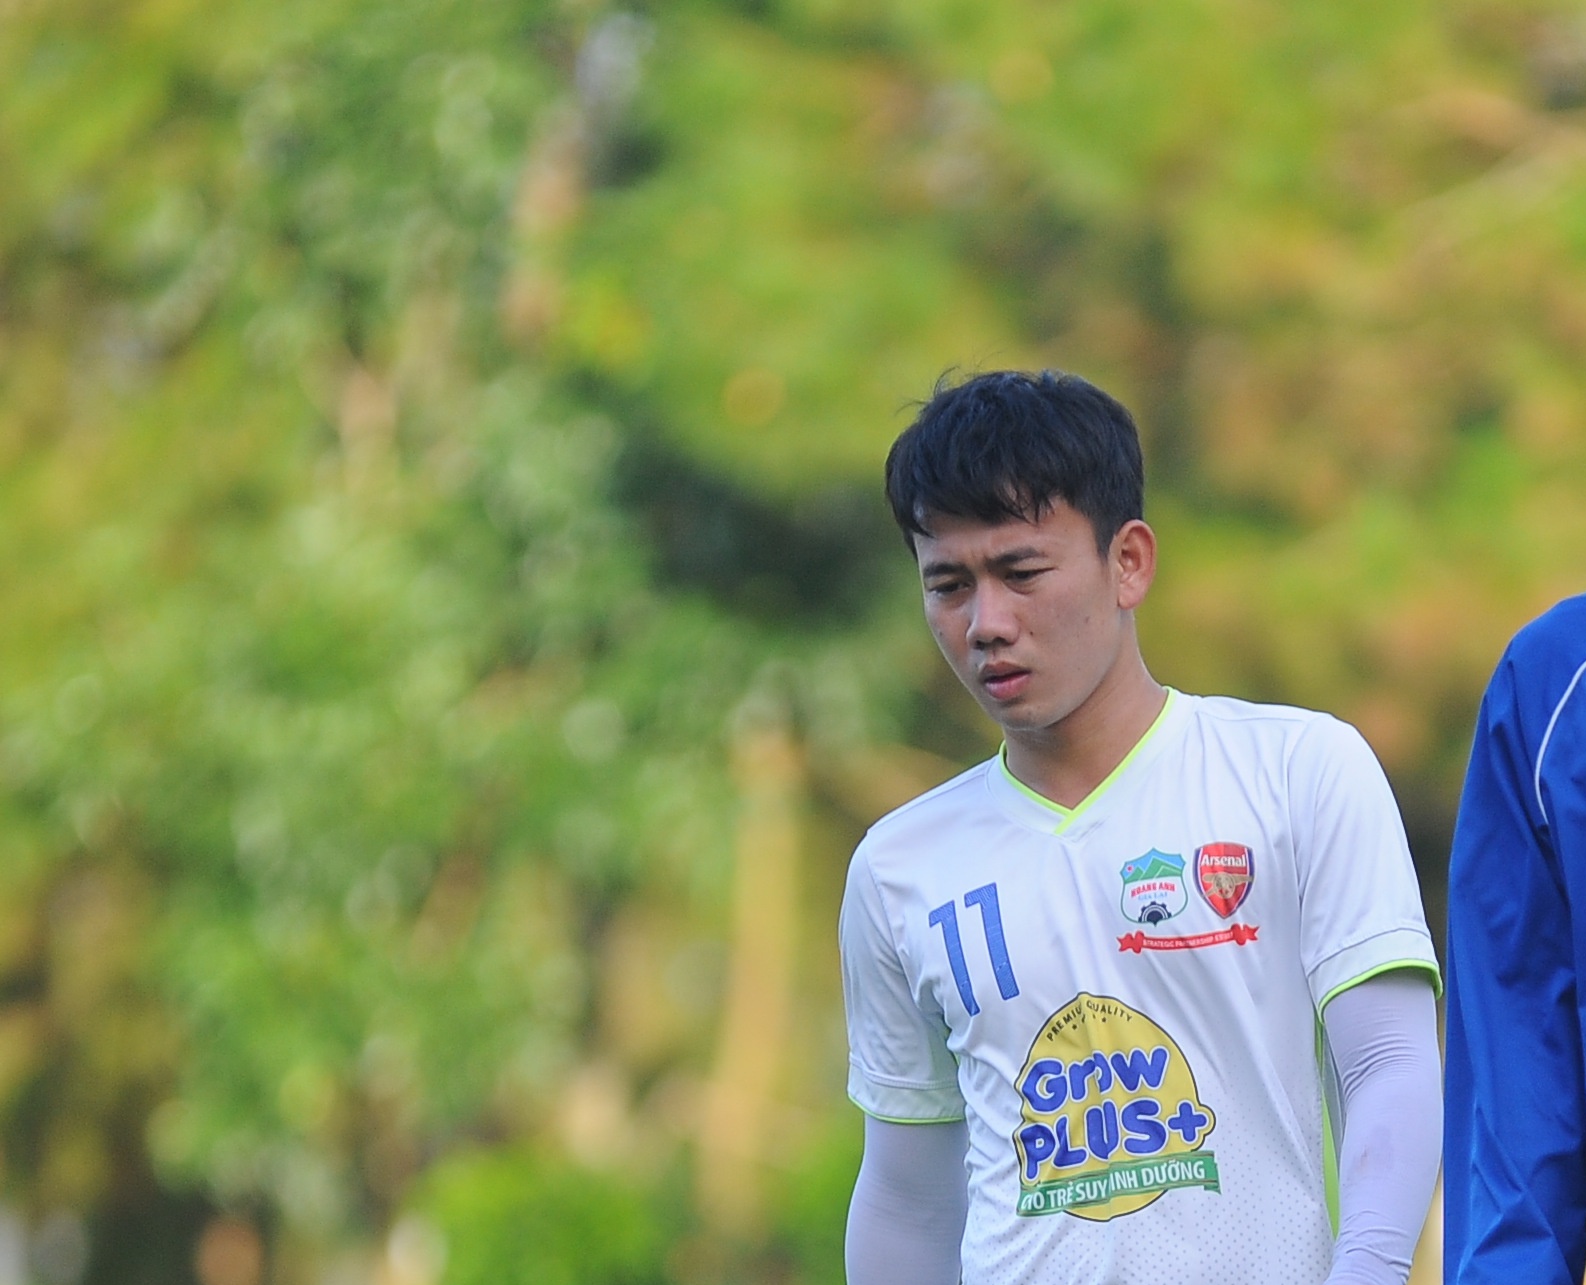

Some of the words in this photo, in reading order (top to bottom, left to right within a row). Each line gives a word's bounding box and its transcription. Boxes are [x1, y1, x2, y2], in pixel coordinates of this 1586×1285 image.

[1201, 853, 1247, 867] Arsenal
[928, 881, 1021, 1018] 11
[1046, 1004, 1083, 1042] PREMIU
[1086, 999, 1133, 1022] QUALITY
[1019, 1099, 1208, 1180] PLUS+
[1075, 1178, 1109, 1202] SUY
[1109, 1171, 1138, 1192] INH
[1142, 1158, 1206, 1185] DƯỠNG
